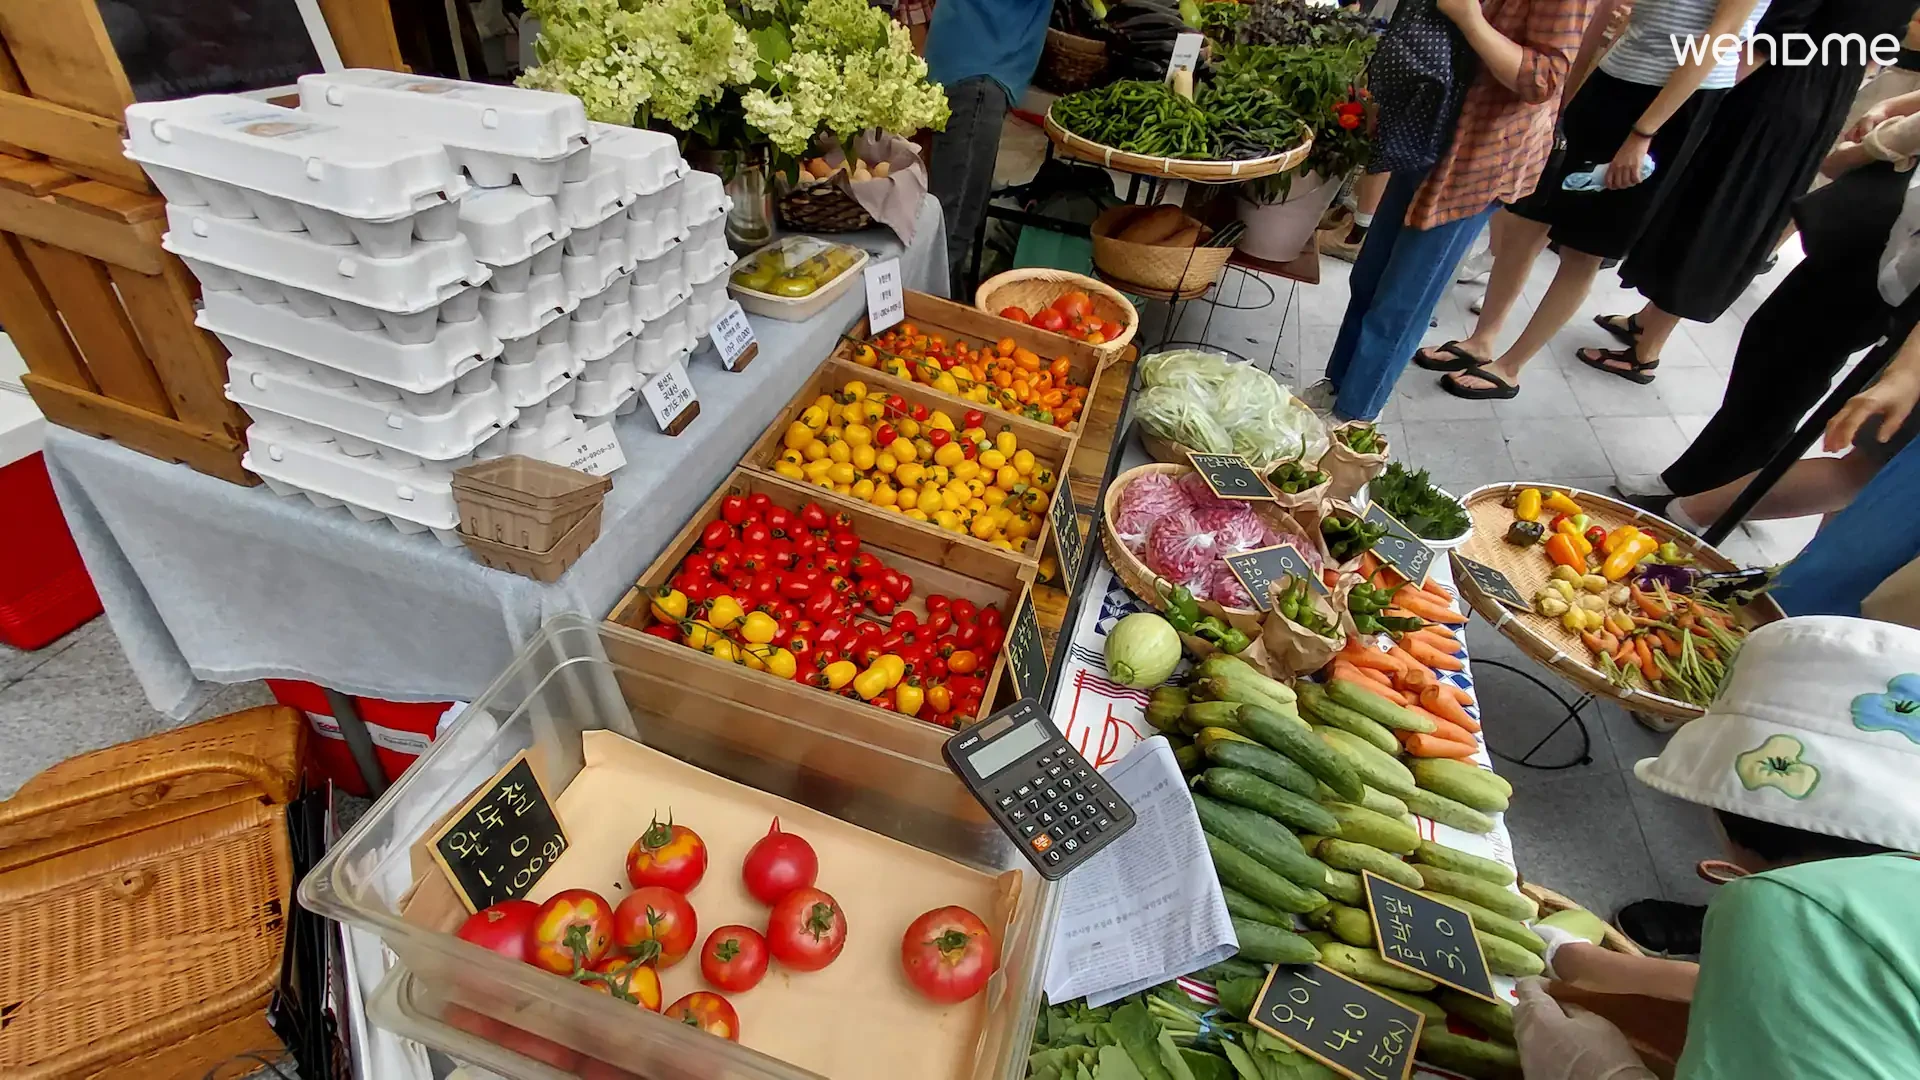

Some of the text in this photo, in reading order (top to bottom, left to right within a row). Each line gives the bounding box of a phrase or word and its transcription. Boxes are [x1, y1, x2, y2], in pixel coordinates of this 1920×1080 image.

[656, 372, 674, 392] 원산지
[662, 383, 679, 401] 국내산
[959, 736, 979, 750] CASIO
[1002, 796, 1013, 806] MC
[1019, 786, 1030, 795] MR
[1030, 799, 1039, 809] 7
[1047, 789, 1057, 799] 8
[1063, 778, 1071, 788] 9
[1044, 792, 1084, 822] 4 5 6
[1055, 827, 1064, 836] 1
[1071, 815, 1080, 825] 2
[1086, 804, 1096, 814] 3
[1050, 839, 1078, 861] 0 00
[1382, 895, 1428, 967] 호박잎
[1435, 918, 1467, 975] 3.0
[1271, 972, 1322, 1031] 오이
[1324, 1003, 1368, 1051] 4.0
